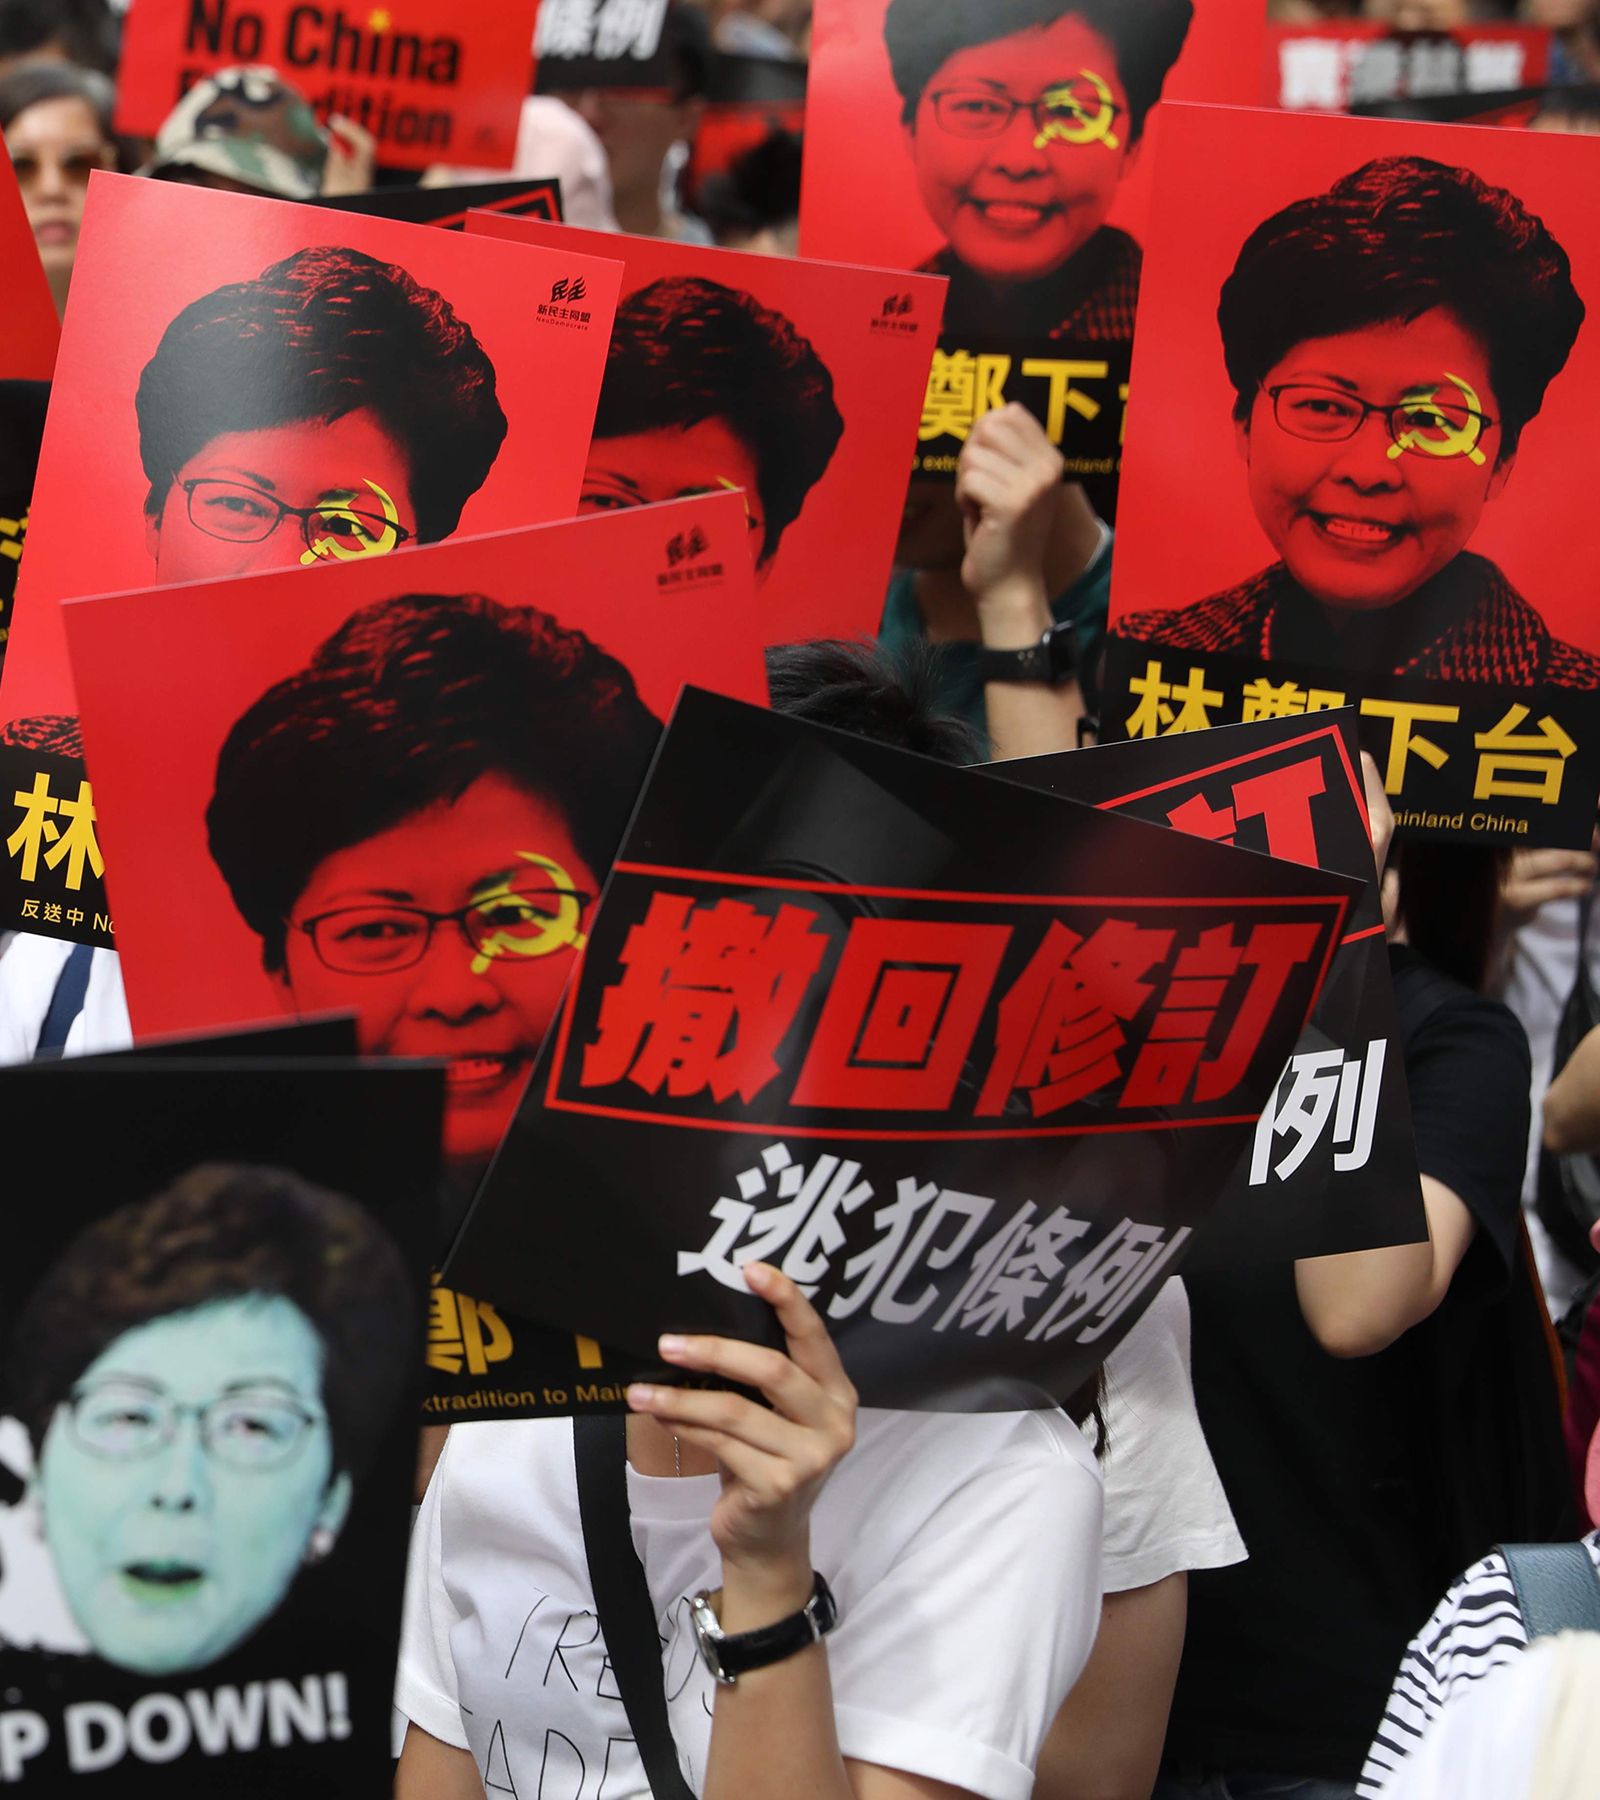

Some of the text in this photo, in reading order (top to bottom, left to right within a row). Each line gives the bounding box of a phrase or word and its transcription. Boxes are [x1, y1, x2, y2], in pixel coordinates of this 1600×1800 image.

[185, 0, 461, 85] No China
[917, 347, 1130, 446] 鄭下
[7, 772, 106, 890] 林
[1392, 808, 1529, 834] ainland China
[21, 899, 84, 927] 反送中
[582, 891, 1322, 1118] 撤回修訂
[1249, 1038, 1388, 1186] 例
[676, 1142, 1191, 1345] 逃犯條例
[542, 1384, 568, 1404] to
[66, 1675, 351, 1774] DOWN!
